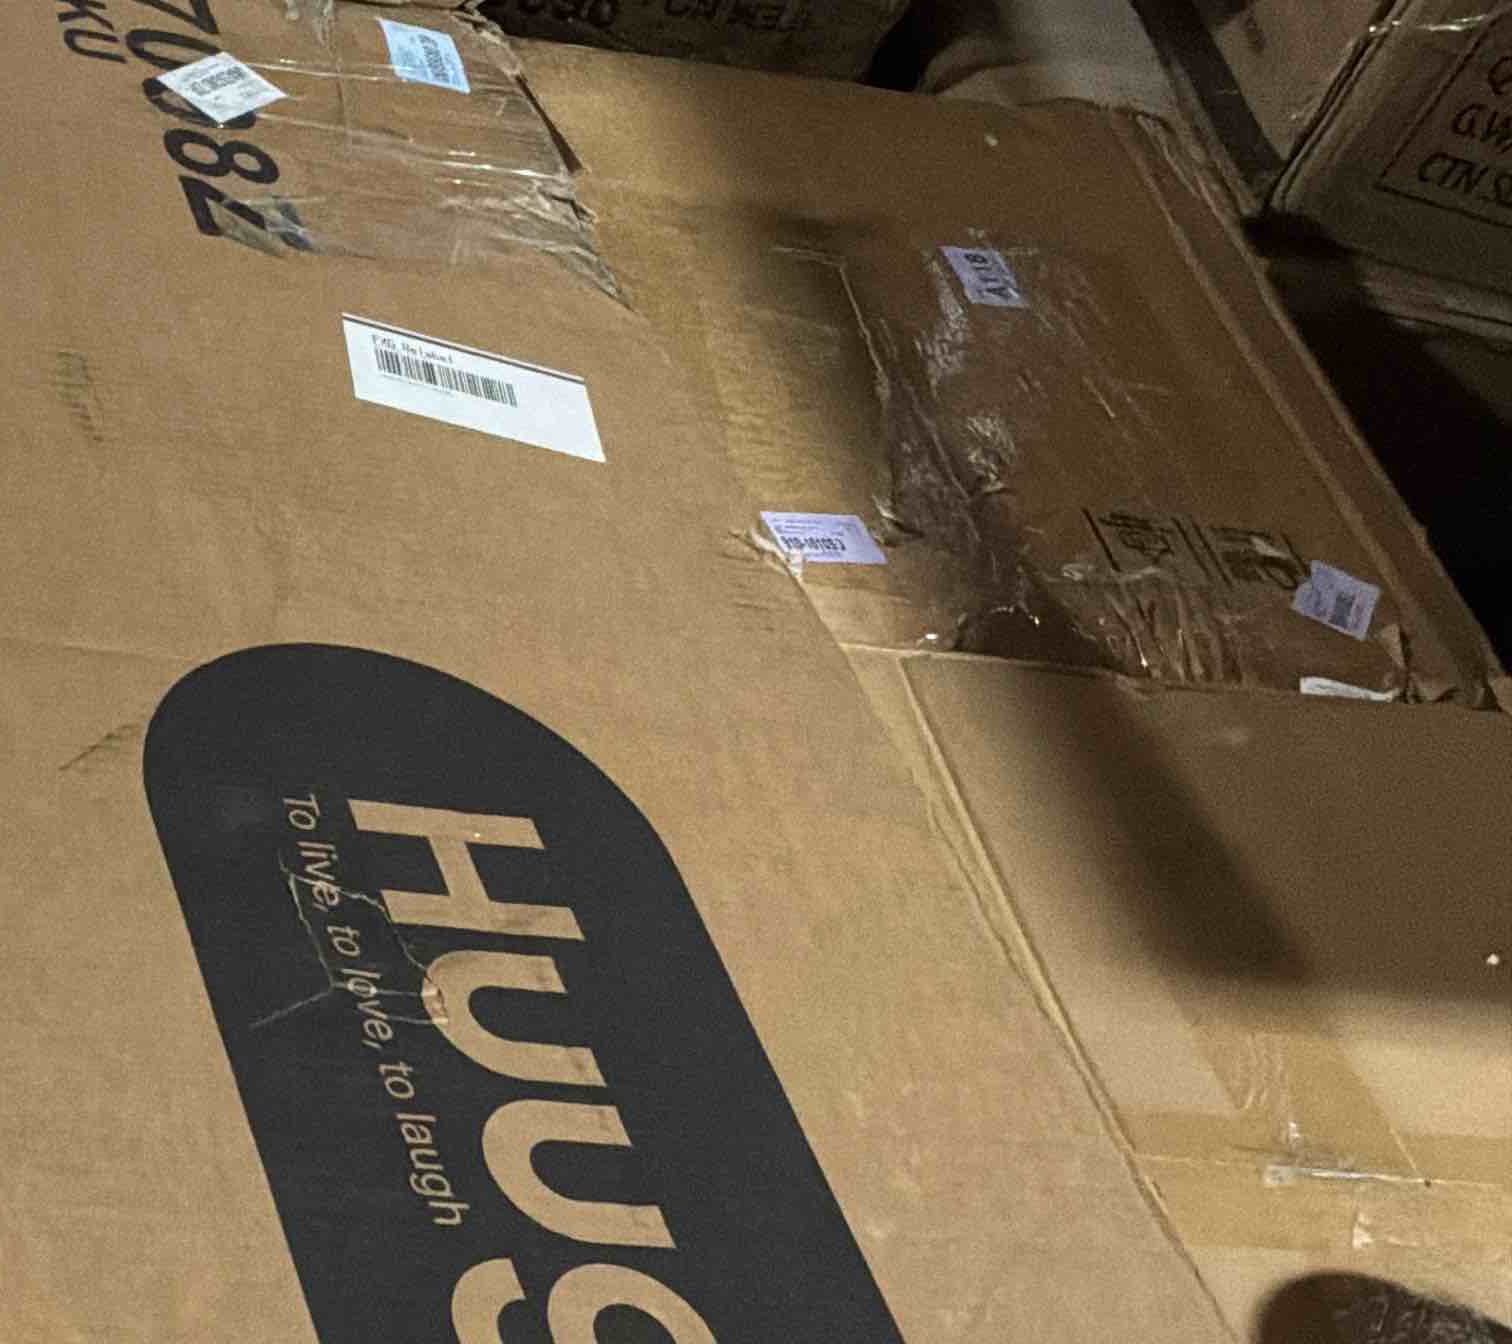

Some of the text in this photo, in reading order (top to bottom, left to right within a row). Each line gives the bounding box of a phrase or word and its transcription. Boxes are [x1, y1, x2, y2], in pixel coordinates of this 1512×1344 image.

[282, 793, 470, 1227] To live, to love, to laugh
